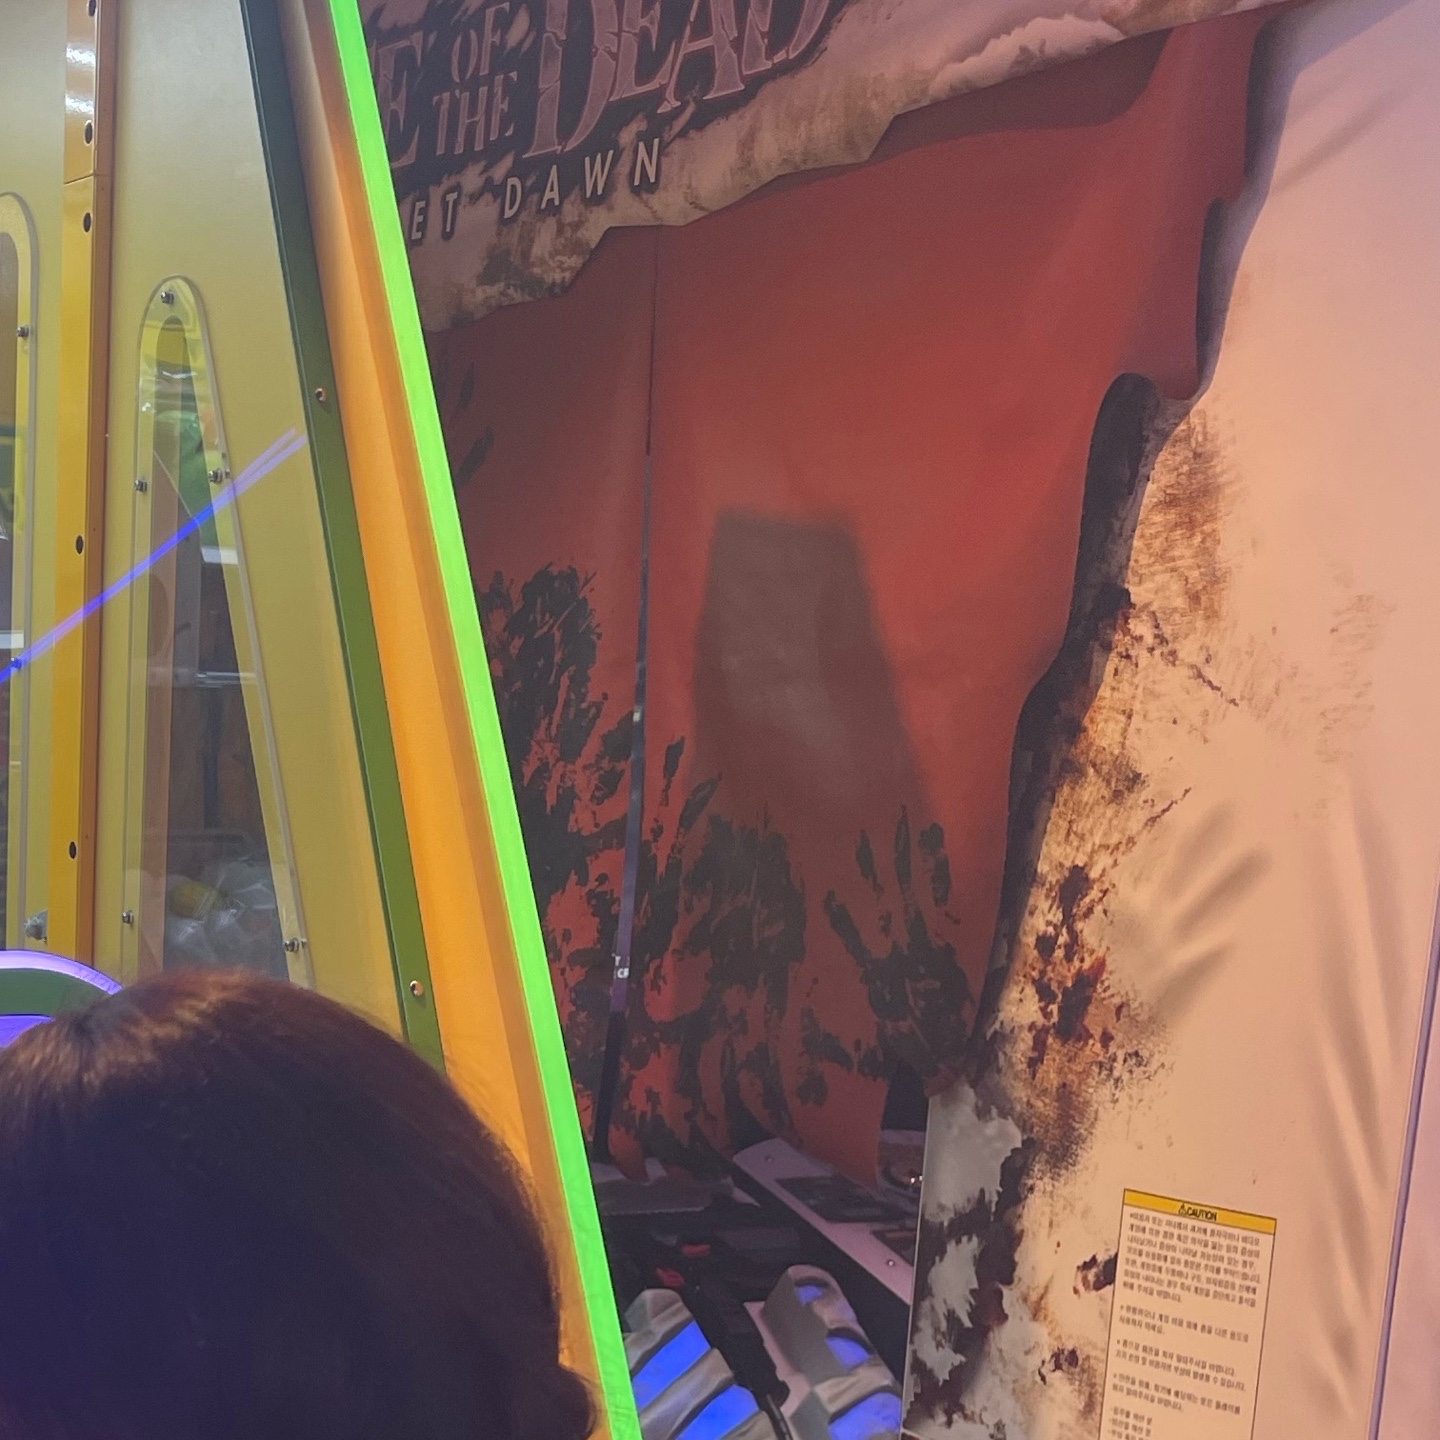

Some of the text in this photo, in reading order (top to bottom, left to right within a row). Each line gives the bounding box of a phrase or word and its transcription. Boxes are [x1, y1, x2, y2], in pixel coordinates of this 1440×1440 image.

[451, 1, 510, 83] OF
[432, 71, 518, 157] THE
[504, 137, 661, 220] DAWN
[1186, 1206, 1217, 1221] CAUTION
